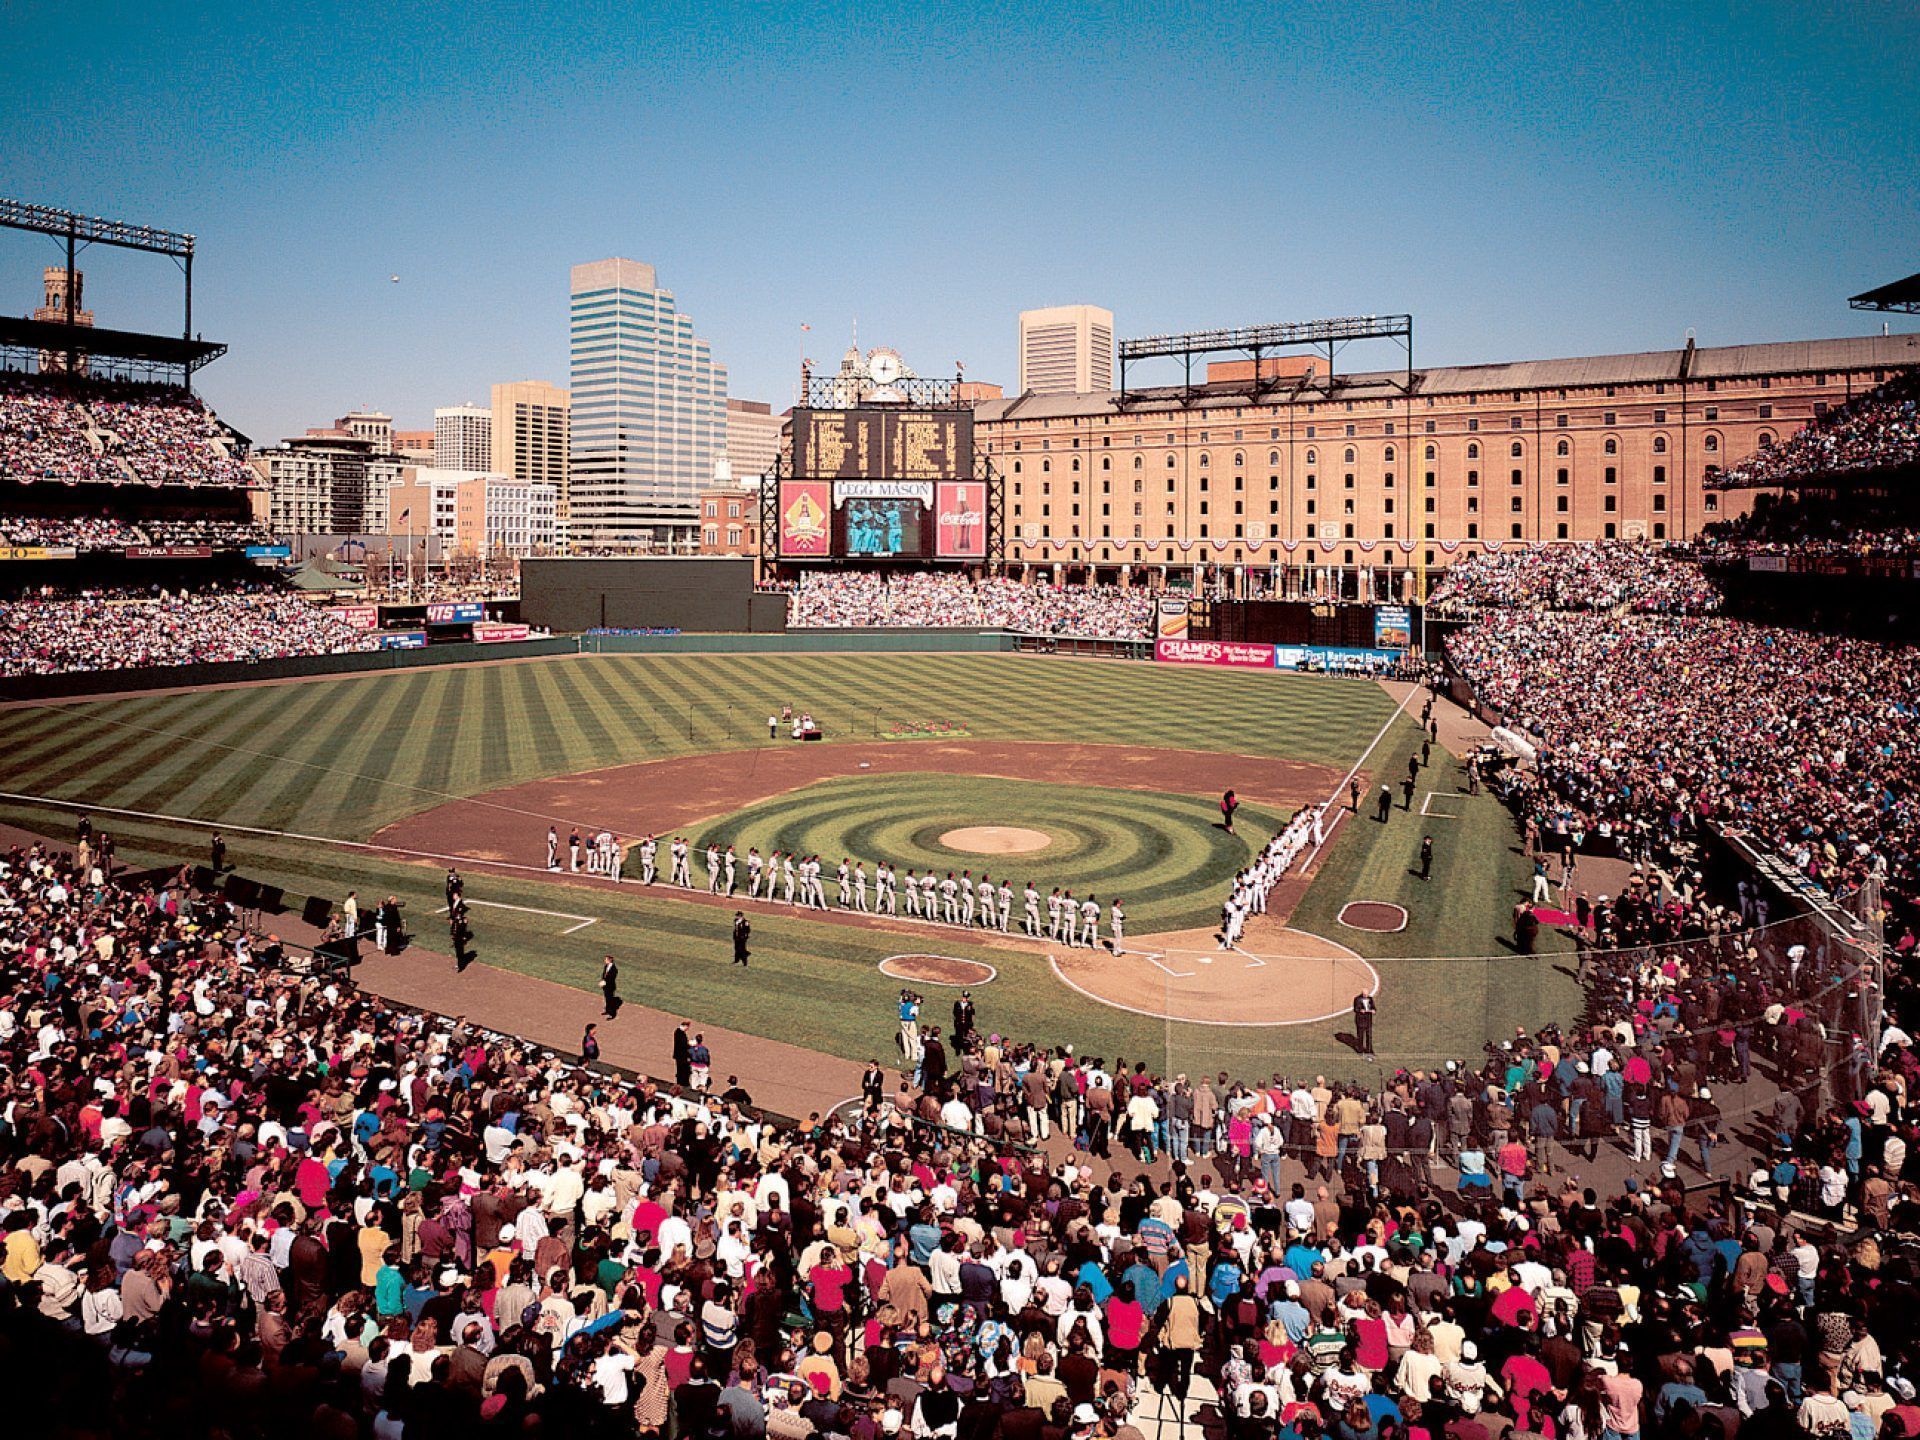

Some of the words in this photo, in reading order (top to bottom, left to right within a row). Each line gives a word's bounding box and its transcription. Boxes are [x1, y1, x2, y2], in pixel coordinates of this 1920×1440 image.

[837, 483, 874, 496] LEGG
[879, 483, 930, 496] MASON
[1159, 641, 1222, 659] CHAMPS
[1327, 650, 1364, 663] National
[1365, 652, 1389, 664] Bank
